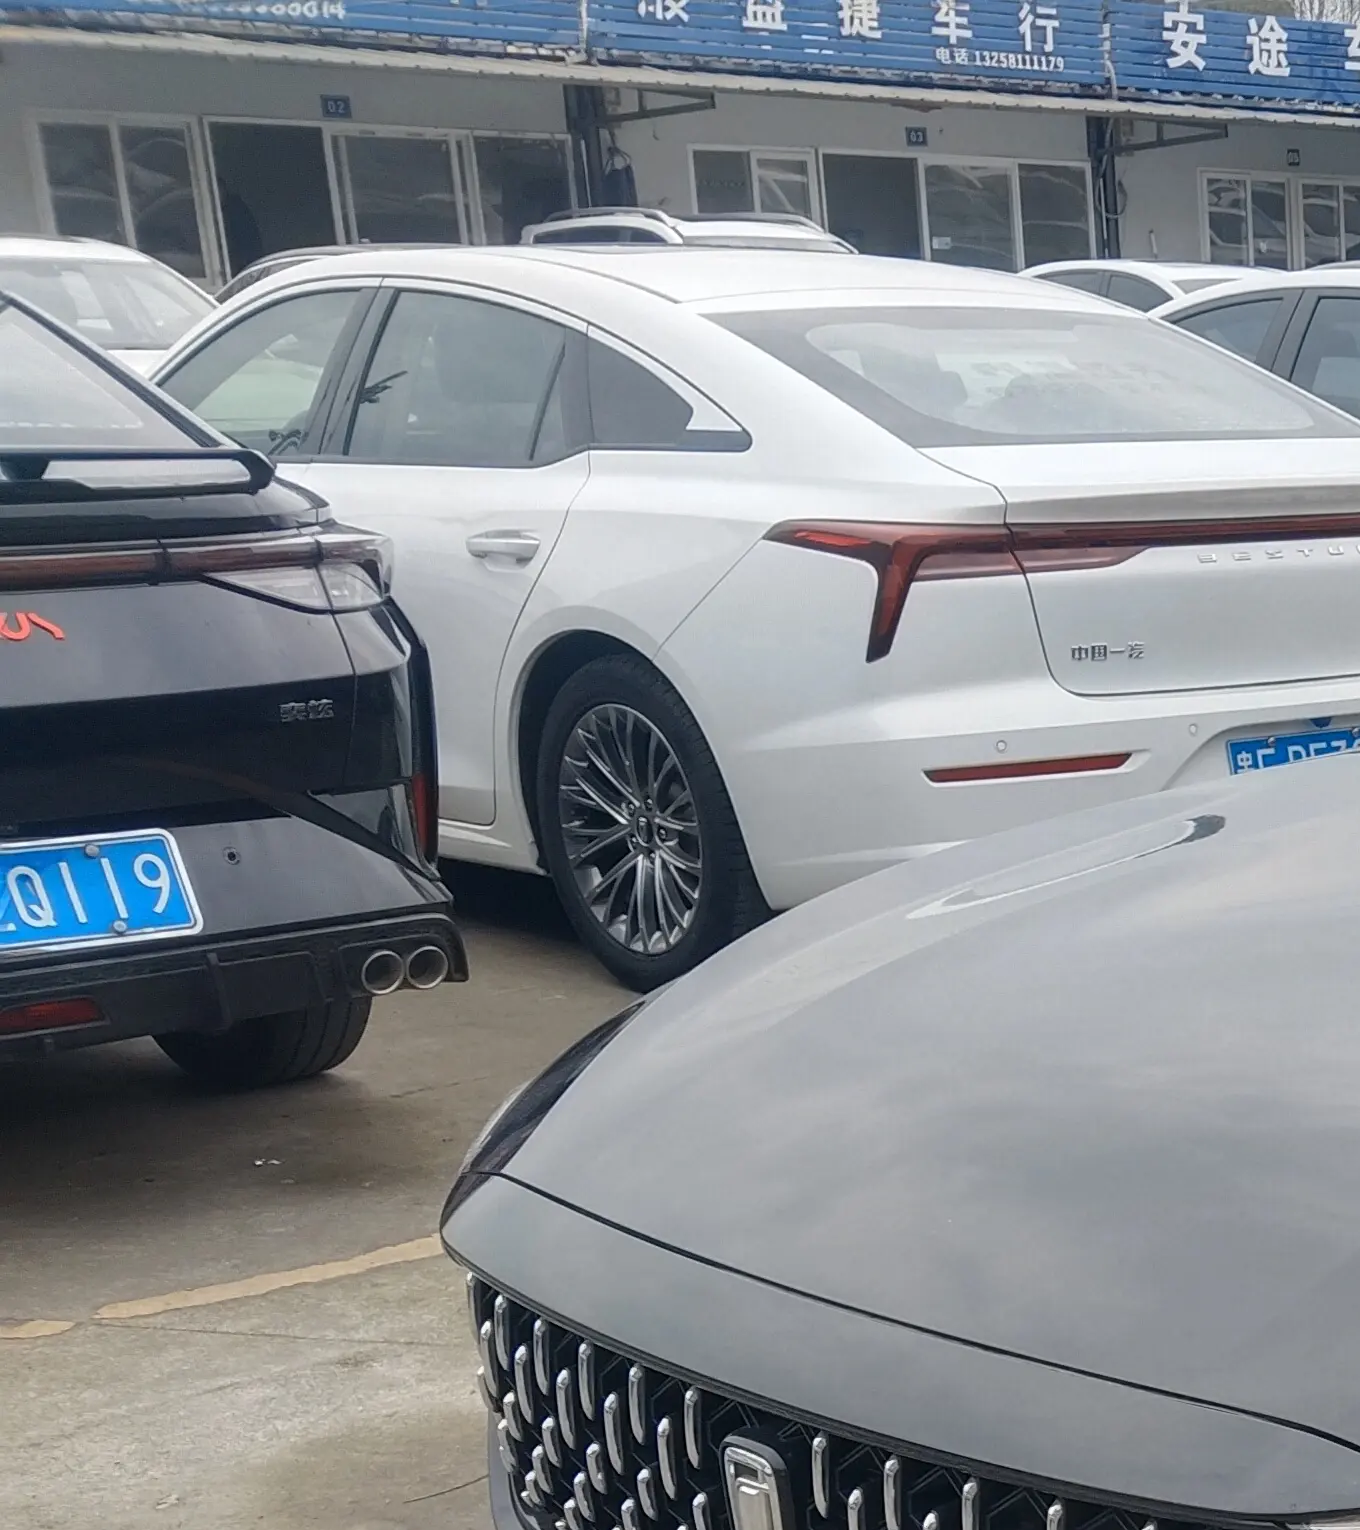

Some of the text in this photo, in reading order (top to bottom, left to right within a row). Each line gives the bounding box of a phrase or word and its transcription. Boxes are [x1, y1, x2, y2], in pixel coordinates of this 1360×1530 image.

[936, 46, 1064, 72] 电话 13258111179
[1071, 641, 1146, 662] 中国一汽
[0, 853, 171, 929] Q119
